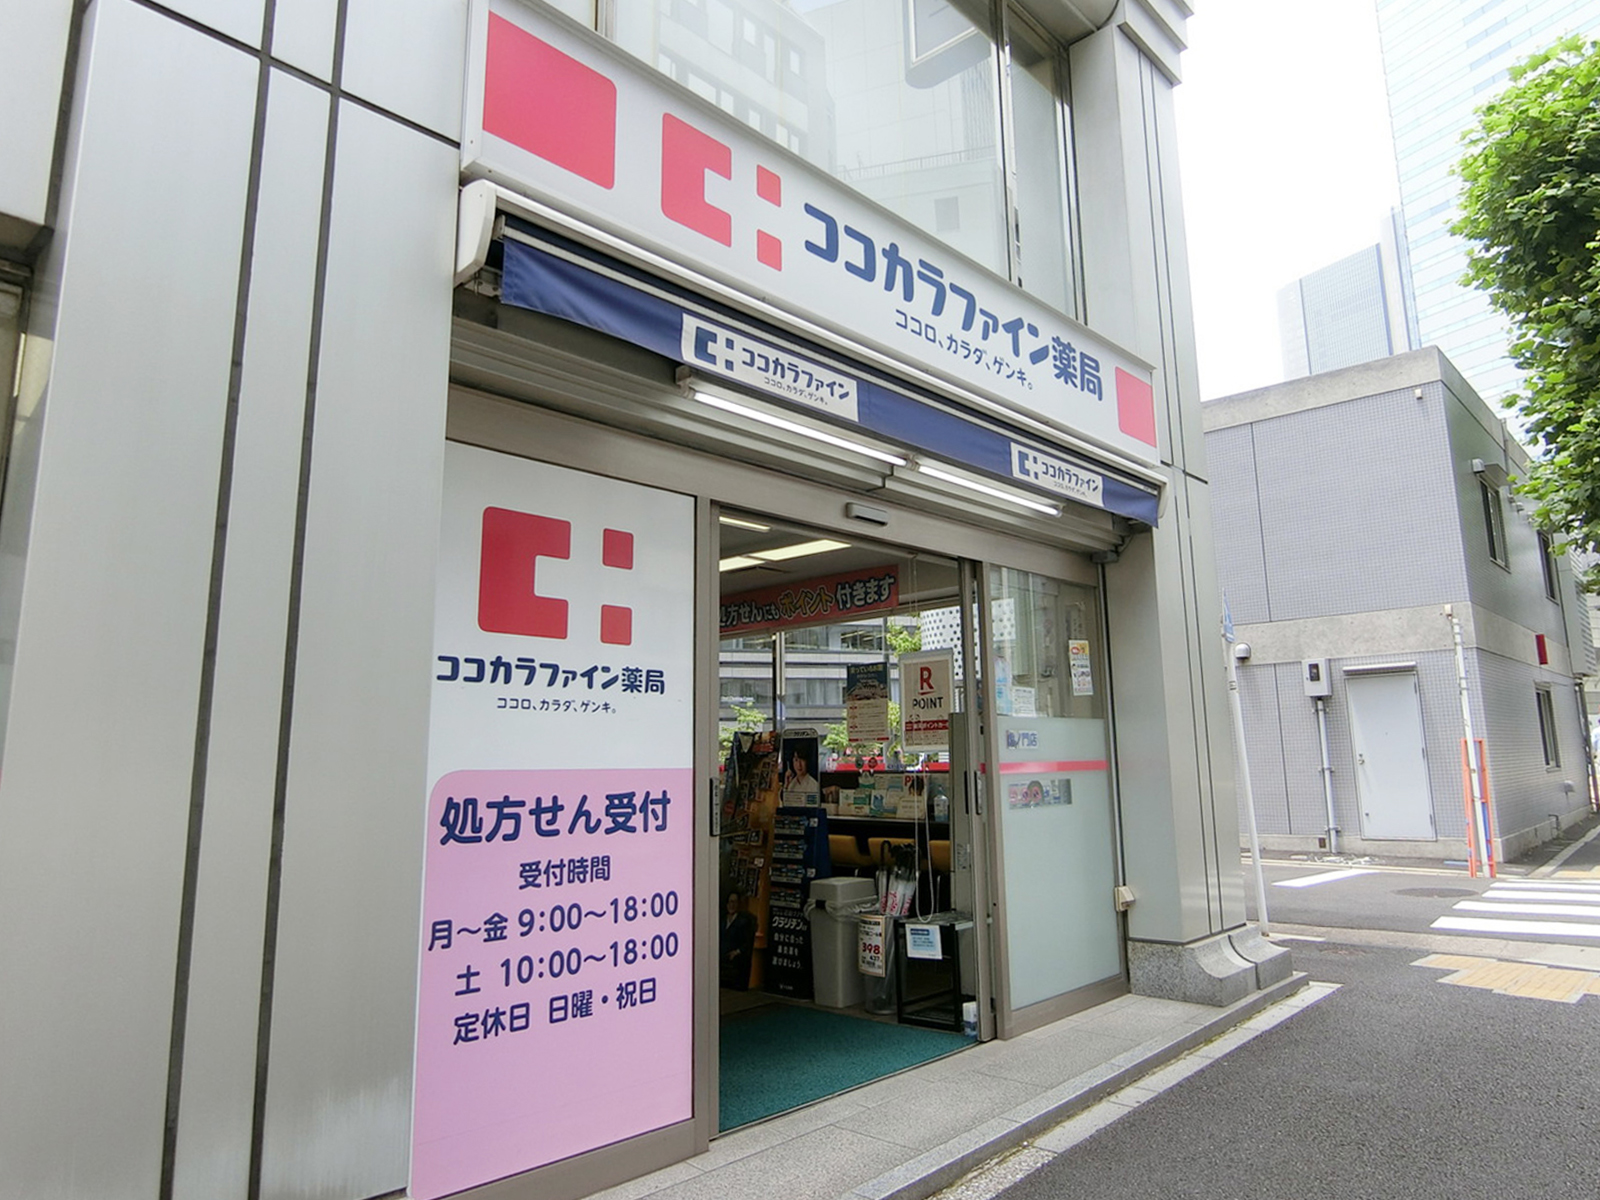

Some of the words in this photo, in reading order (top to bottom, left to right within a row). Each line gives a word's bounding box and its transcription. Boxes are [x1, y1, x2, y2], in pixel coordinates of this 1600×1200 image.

[803, 202, 1103, 401] ココカラファイン薬局
[895, 308, 1034, 391] ココロ、カラダ、ゲンキ。
[742, 347, 850, 400] ココカラファイン
[1041, 461, 1099, 492] ココカラファイン
[436, 654, 666, 696] ココカラファイン薬局
[496, 696, 617, 715] ココロ、カラダ、ゲンキ。
[913, 697, 943, 710] POINT
[439, 790, 671, 846] 処方せん受付
[518, 855, 611, 890] 受付時間
[862, 942, 881, 955] 398
[454, 965, 481, 997] 土
[453, 1002, 531, 1046] 定休日
[548, 976, 658, 1025] 日曜・祝日
